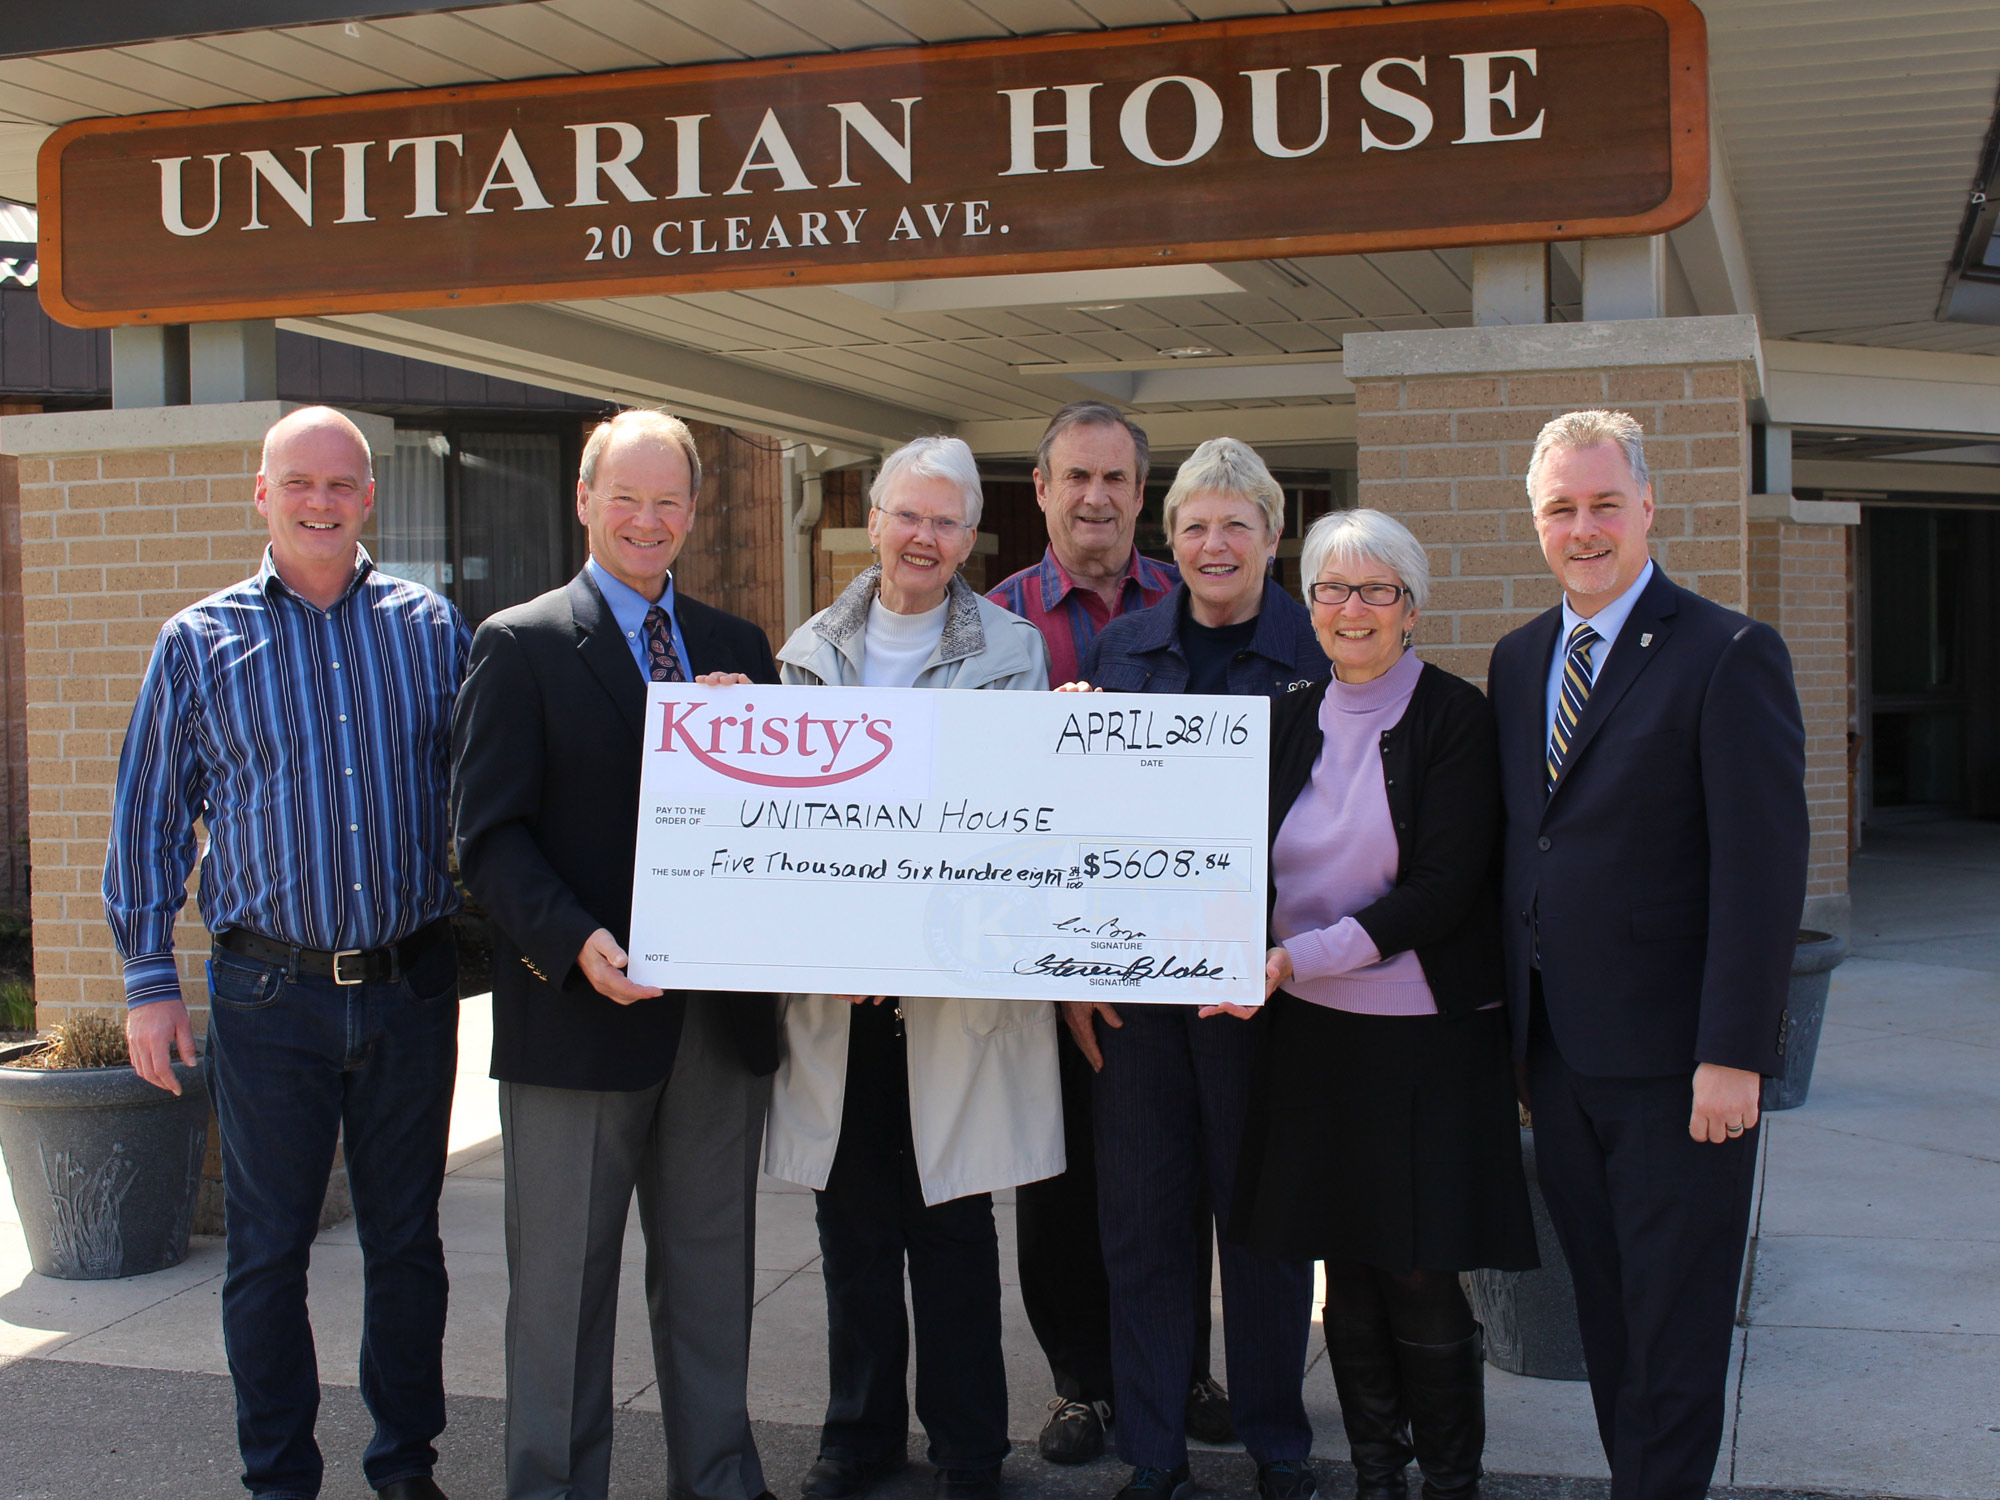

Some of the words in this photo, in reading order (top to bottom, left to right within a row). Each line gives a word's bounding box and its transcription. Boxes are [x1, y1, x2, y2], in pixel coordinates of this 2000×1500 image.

[152, 96, 924, 238] UNITARIAN
[996, 47, 1548, 179] HOUSE
[584, 224, 632, 261] 20
[652, 208, 867, 256] CLEARY
[888, 200, 1010, 241] AVE.
[1055, 709, 1163, 754] APRIL
[1165, 711, 1248, 746] 28/16
[654, 701, 893, 788] Kristy's
[1140, 759, 1163, 767] DATE
[656, 806, 673, 814] PAY
[675, 807, 687, 815] TO
[689, 807, 706, 815] THE
[740, 799, 922, 829] UNITARIAN
[939, 798, 1055, 833] HOUSE
[655, 816, 687, 825] ORDER
[688, 817, 701, 825] OF
[711, 848, 755, 875] Five
[764, 851, 888, 880] Thousand
[652, 868, 669, 876] THE
[671, 868, 691, 877] SUM
[692, 869, 705, 877] OF
[1089, 941, 1143, 950] SIGNATURE
[645, 953, 669, 962] NOTE
[1088, 978, 1142, 987] SIGNATURE
